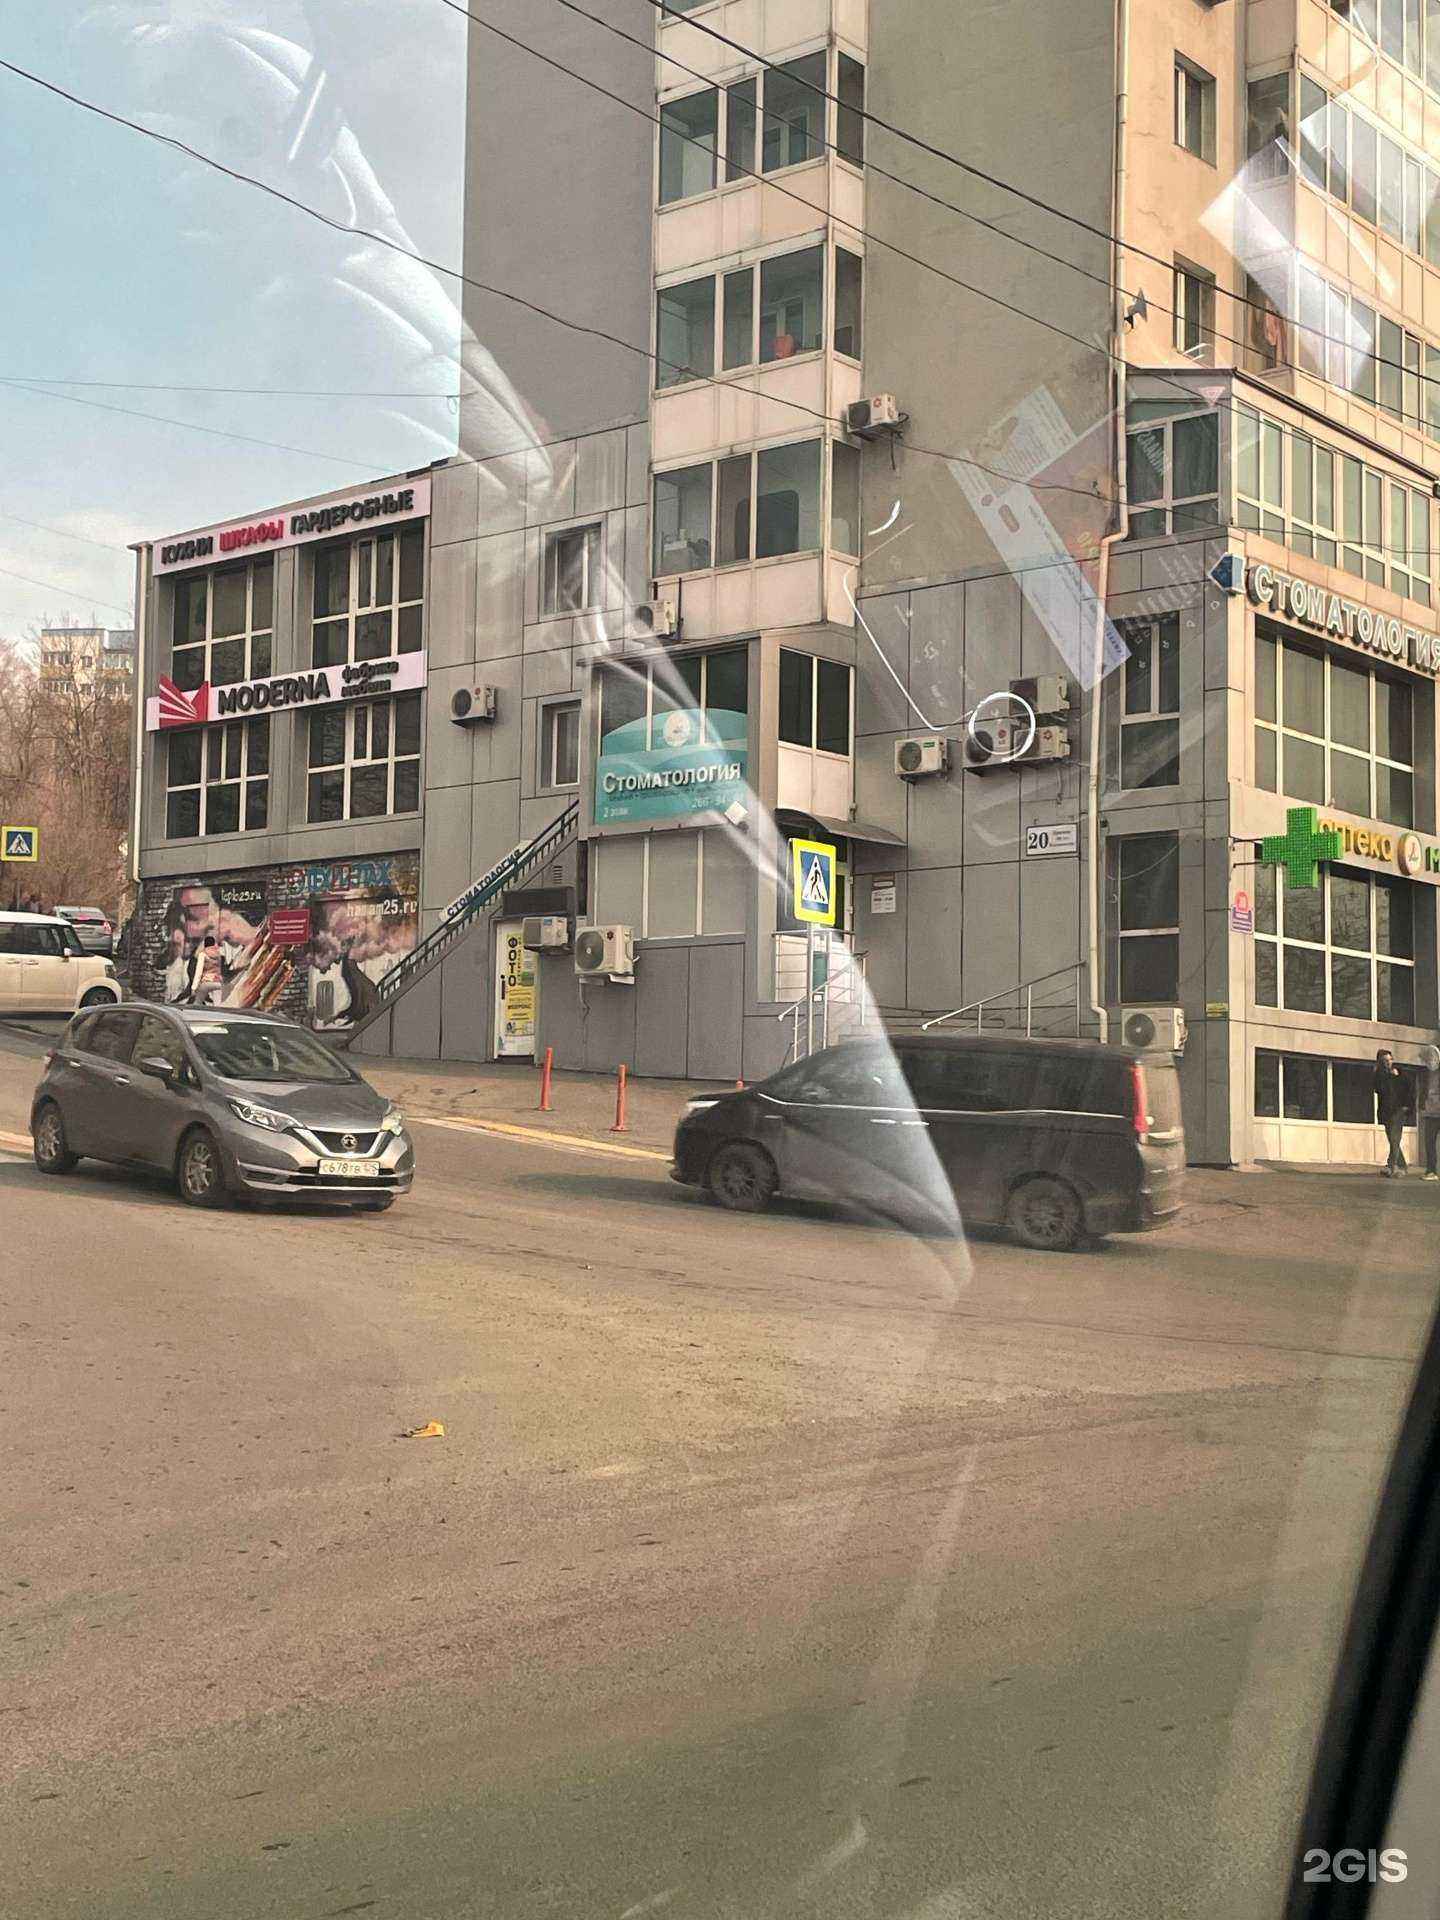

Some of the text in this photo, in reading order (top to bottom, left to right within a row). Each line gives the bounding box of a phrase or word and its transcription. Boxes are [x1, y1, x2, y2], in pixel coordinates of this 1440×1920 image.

[161, 489, 414, 565] КУХНИ ШКАФЫ ГАРДЕРОБНЫЕ
[1252, 564, 1440, 673] СТОМАТОЛОГИЯ
[218, 672, 331, 715] MODERNA
[1028, 831, 1049, 849] 20
